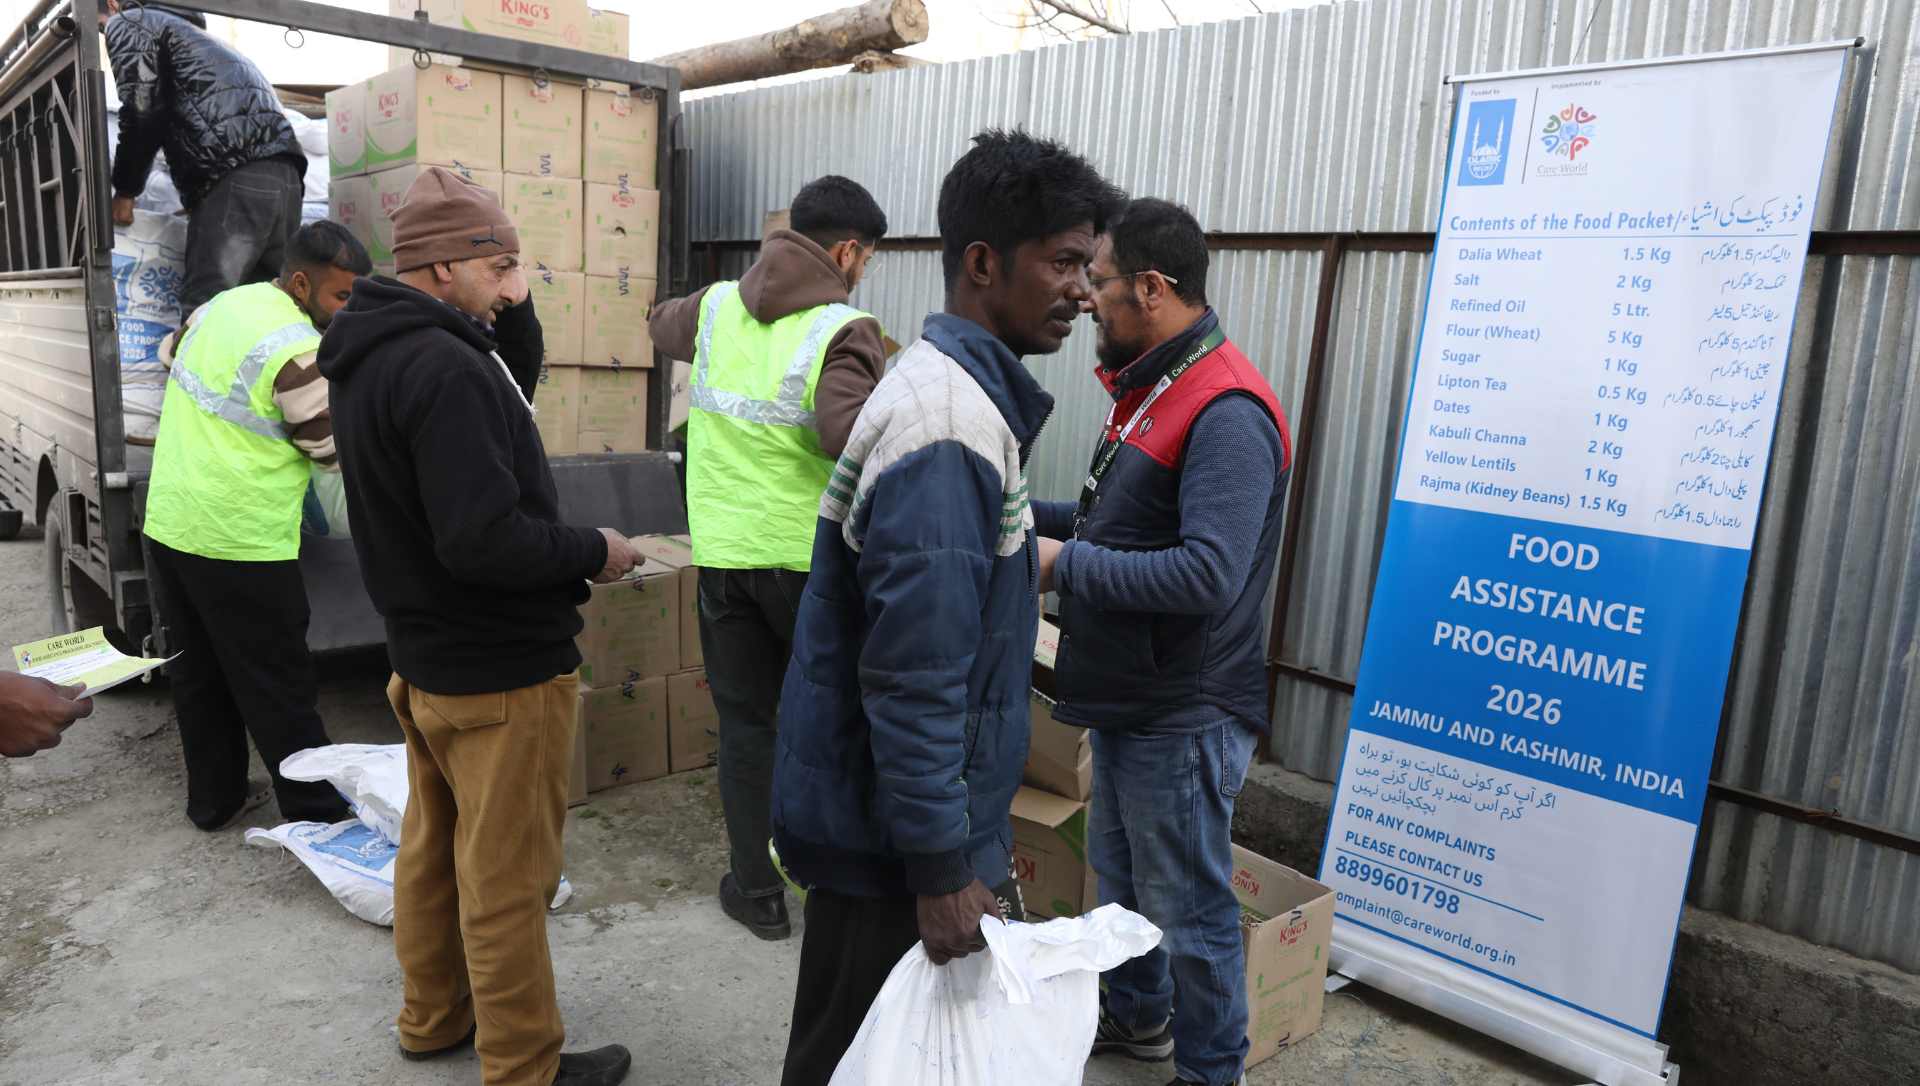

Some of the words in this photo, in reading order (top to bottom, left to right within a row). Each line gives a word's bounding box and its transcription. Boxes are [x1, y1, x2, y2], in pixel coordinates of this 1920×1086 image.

[500, 0, 550, 20] KING'S
[1560, 162, 1588, 174] World
[1450, 213, 1515, 231] Contents
[1520, 213, 1537, 229] of
[1543, 213, 1568, 229] the
[1574, 213, 1613, 229] Food
[1458, 247, 1493, 261] Dalia
[1496, 247, 1542, 261] Wheat
[1623, 247, 1645, 261] 1.5
[1650, 248, 1671, 265] Kg
[1454, 274, 1479, 287] Salt
[1617, 276, 1626, 288] 2
[1631, 275, 1651, 293] Kg
[1450, 298, 1500, 312] Refined
[1504, 299, 1525, 313] Oil
[1612, 303, 1621, 316] 5
[1626, 304, 1650, 317] Ltr.
[1446, 324, 1480, 338] Flour
[1484, 326, 1541, 342] (Wheat)
[1608, 332, 1617, 345] 5
[1622, 331, 1642, 348] Kg
[1171, 361, 1188, 378] Care
[1186, 344, 1208, 363] World
[1441, 350, 1480, 365] Sugar
[1604, 358, 1612, 371] 1
[1617, 358, 1638, 375] Kg
[1437, 375, 1482, 391] Lipton
[1484, 379, 1507, 392] Tea
[1597, 385, 1621, 399] 0.5
[1626, 387, 1647, 405] Kg
[1433, 400, 1470, 415] Dates
[1594, 413, 1602, 426] 1
[1607, 414, 1628, 431] Kg
[1429, 425, 1471, 442] Kabuli
[1475, 429, 1527, 447] Channa
[1588, 440, 1597, 454] 2
[1602, 441, 1623, 459] Kg
[1095, 460, 1107, 477] Care
[1425, 449, 1467, 467] Yellow
[1471, 454, 1516, 472] Lentils
[1584, 468, 1592, 481] 1
[1597, 470, 1618, 488] Kg
[1420, 475, 1461, 494] Rajma
[1465, 479, 1518, 500] (Kidney
[1521, 486, 1570, 508] Beans)
[1579, 495, 1601, 511] 1.5
[1606, 498, 1628, 518] Kg
[1508, 533, 1600, 571] FOOD
[1450, 575, 1646, 635] ASSISTANCE
[47, 641, 63, 651] CARE
[63, 634, 85, 647] WORLD
[1433, 621, 1647, 691] PROGRAMME
[1486, 685, 1562, 726] 2026
[1369, 700, 1444, 734] JAMMU
[1448, 719, 1495, 747] AND
[1500, 732, 1605, 781] KASHMIR,
[1615, 763, 1685, 799] INDIA
[1497, 783, 1512, 797] کو
[1514, 787, 1536, 804] آپ
[1536, 793, 1556, 809] اگر
[1347, 804, 1373, 822] FOR
[1376, 813, 1404, 831] ANY
[1406, 822, 1496, 861] COMPLAINTS
[1345, 830, 1395, 857] PLEASE
[1399, 847, 1461, 879] CONTACT
[1464, 870, 1483, 887] US
[1335, 855, 1461, 915] 8899601798
[1336, 891, 1516, 966] omplaint@careworld.org.in
